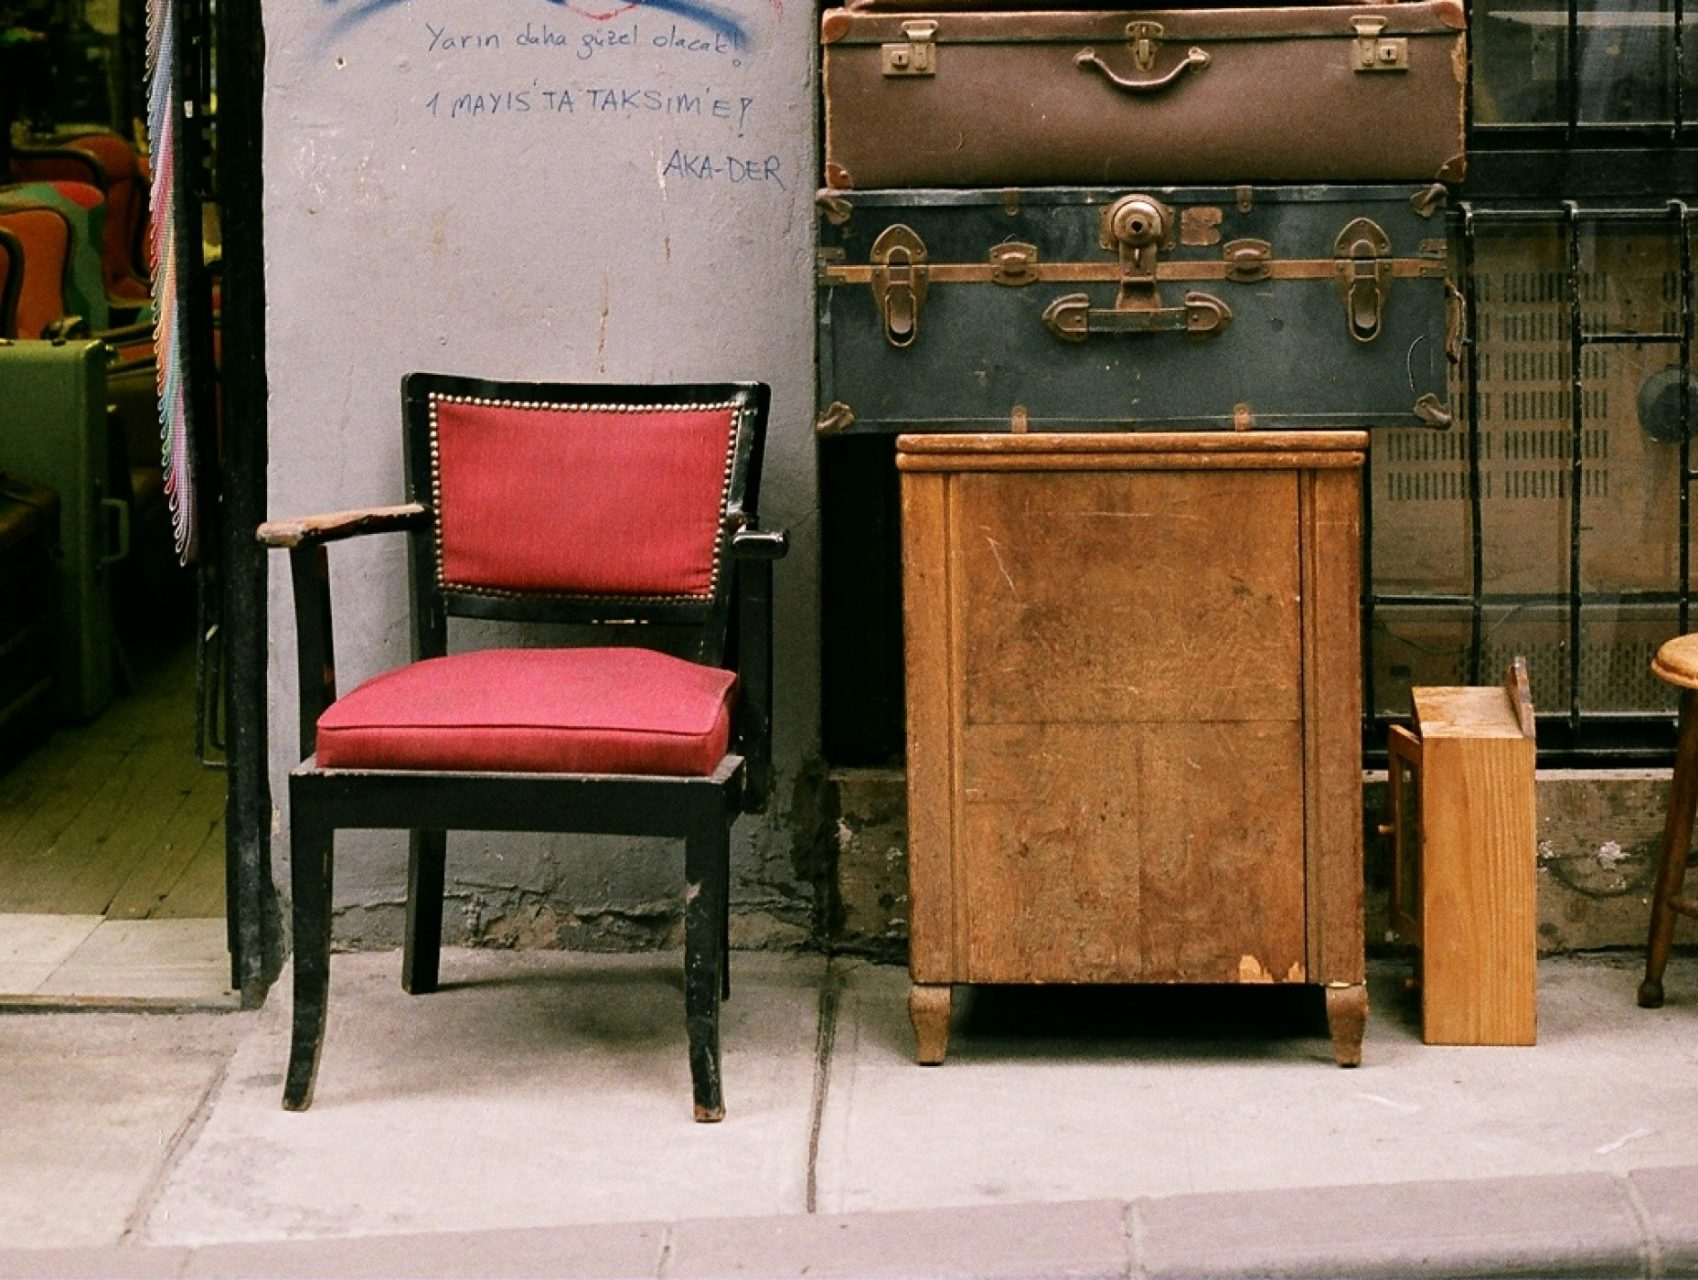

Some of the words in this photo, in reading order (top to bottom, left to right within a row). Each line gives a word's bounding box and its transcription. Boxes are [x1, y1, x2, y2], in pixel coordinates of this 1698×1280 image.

[516, 23, 568, 48] daha
[576, 24, 638, 60] güzel
[426, 91, 440, 118] 1
[662, 149, 787, 192] AKA-DER
